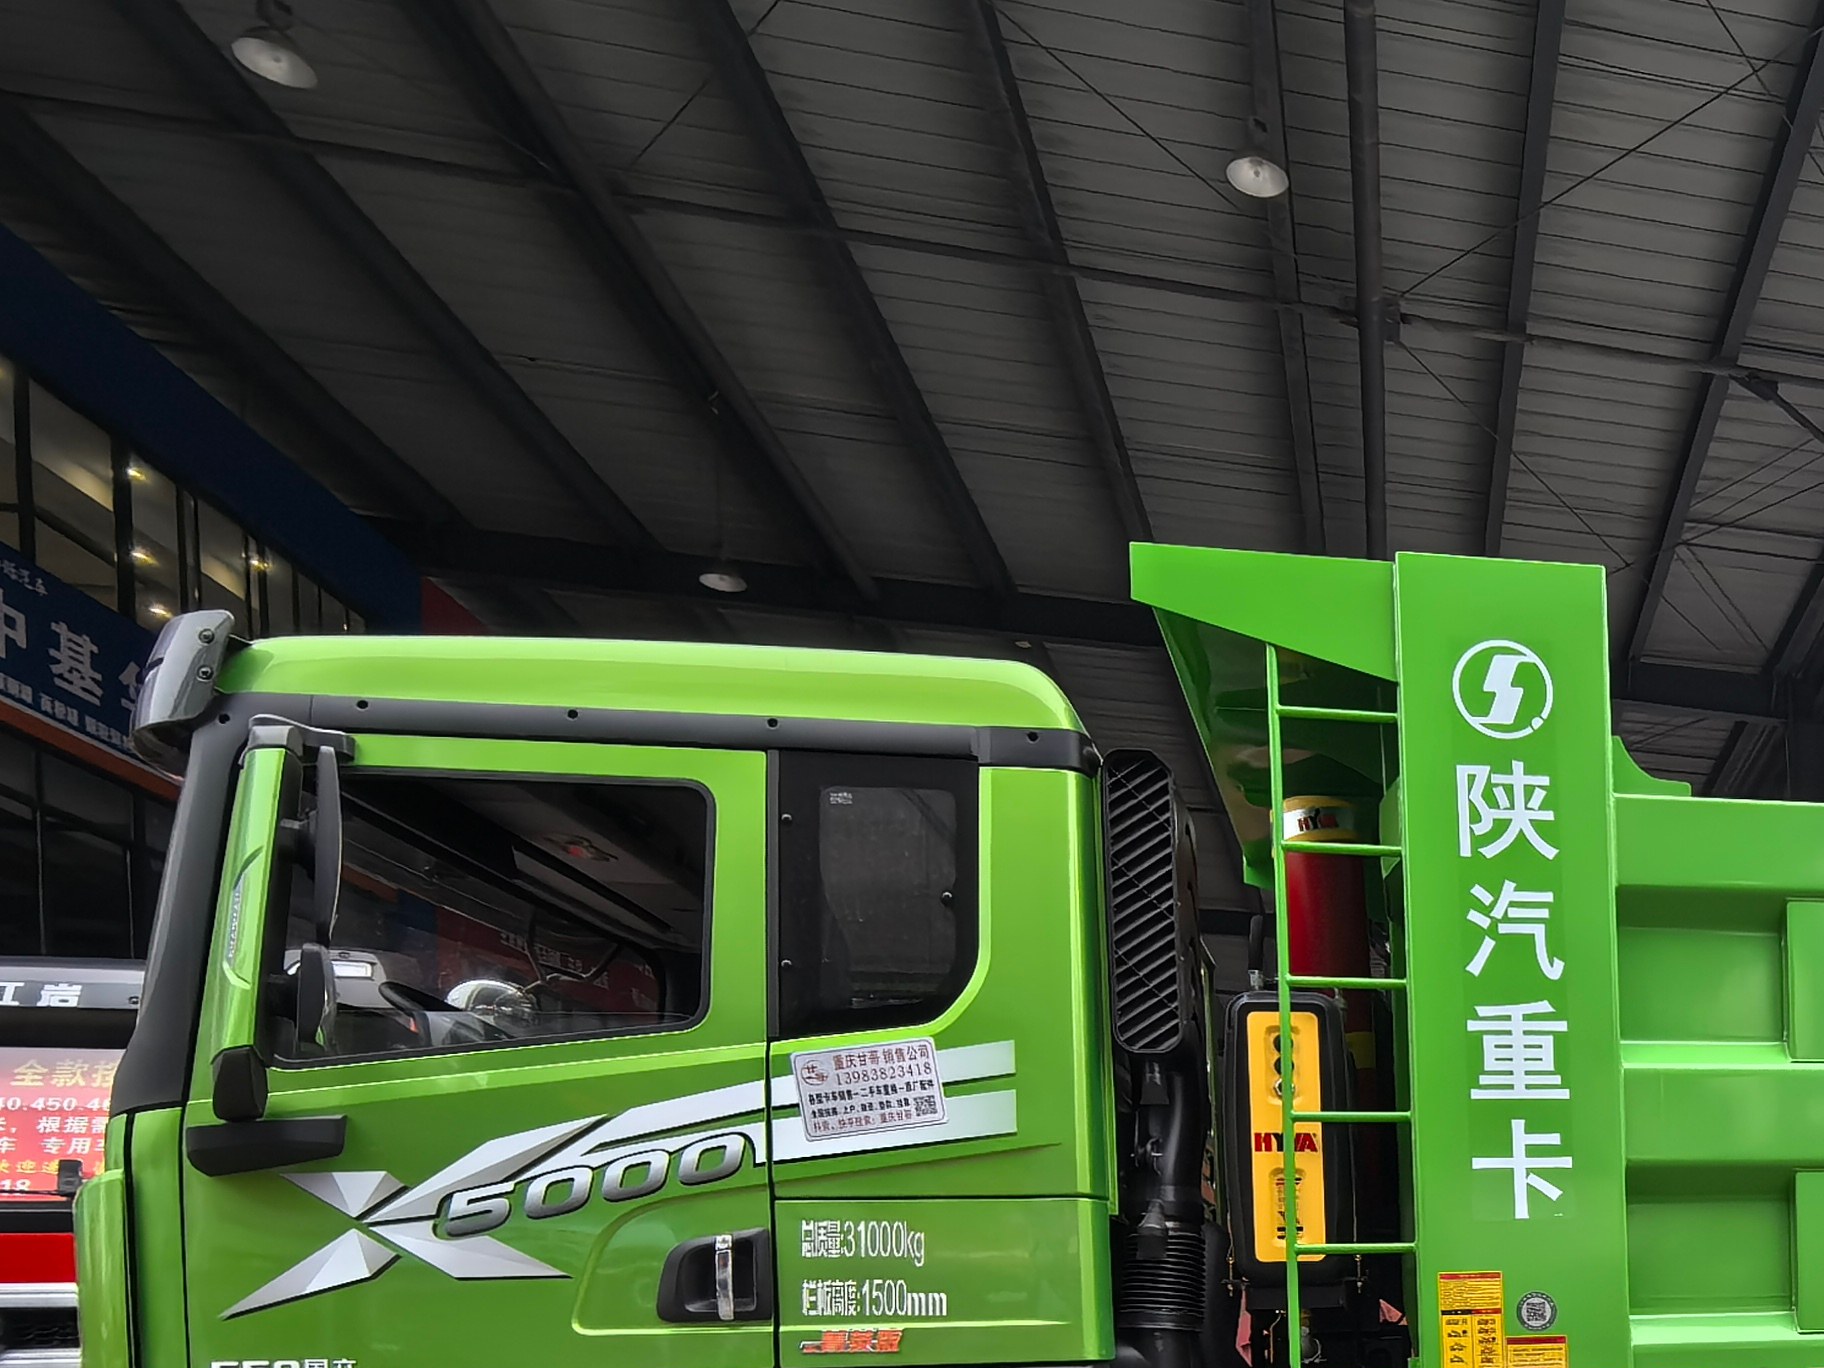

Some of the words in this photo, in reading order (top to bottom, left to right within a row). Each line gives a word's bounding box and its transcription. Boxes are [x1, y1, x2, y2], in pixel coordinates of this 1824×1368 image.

[836, 1061, 933, 1086] 13983823418
[1456, 759, 1573, 1220] 陕汽重卡
